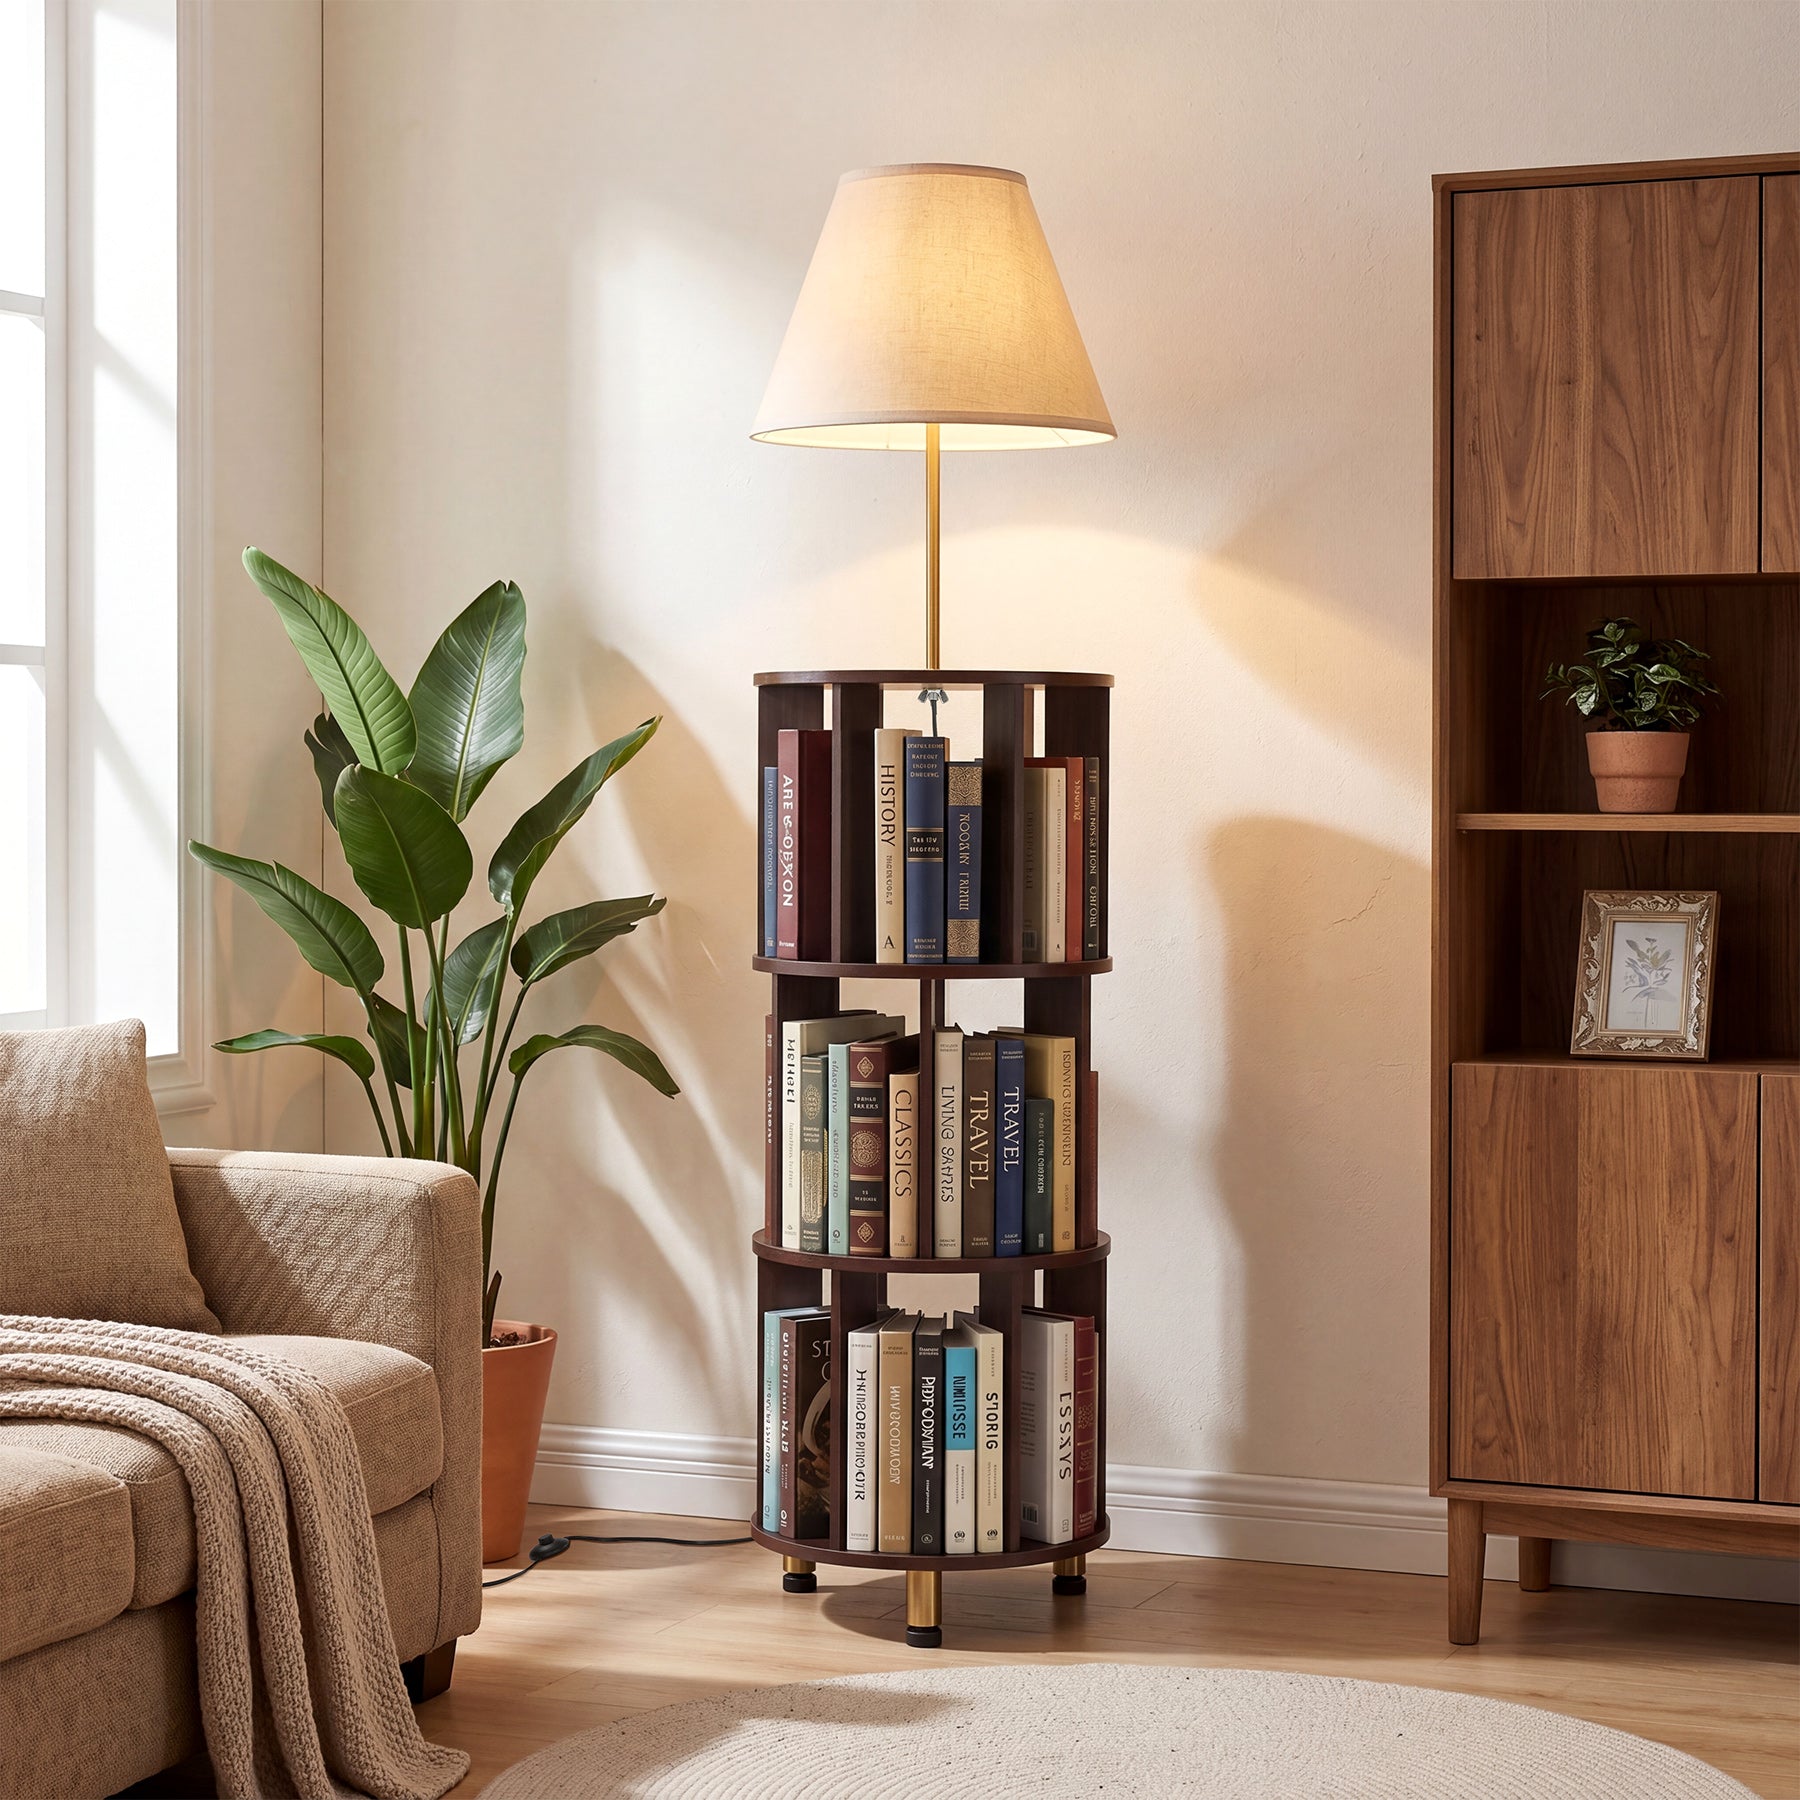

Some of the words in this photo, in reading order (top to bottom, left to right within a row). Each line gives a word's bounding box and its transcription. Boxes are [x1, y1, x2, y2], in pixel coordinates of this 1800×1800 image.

[880, 764, 896, 847] HISTORY
[883, 935, 895, 949] A
[894, 1089, 913, 1198] CLASSICS
[969, 1090, 989, 1189] TRAVEL
[1003, 1086, 1020, 1172] TRAVEL
